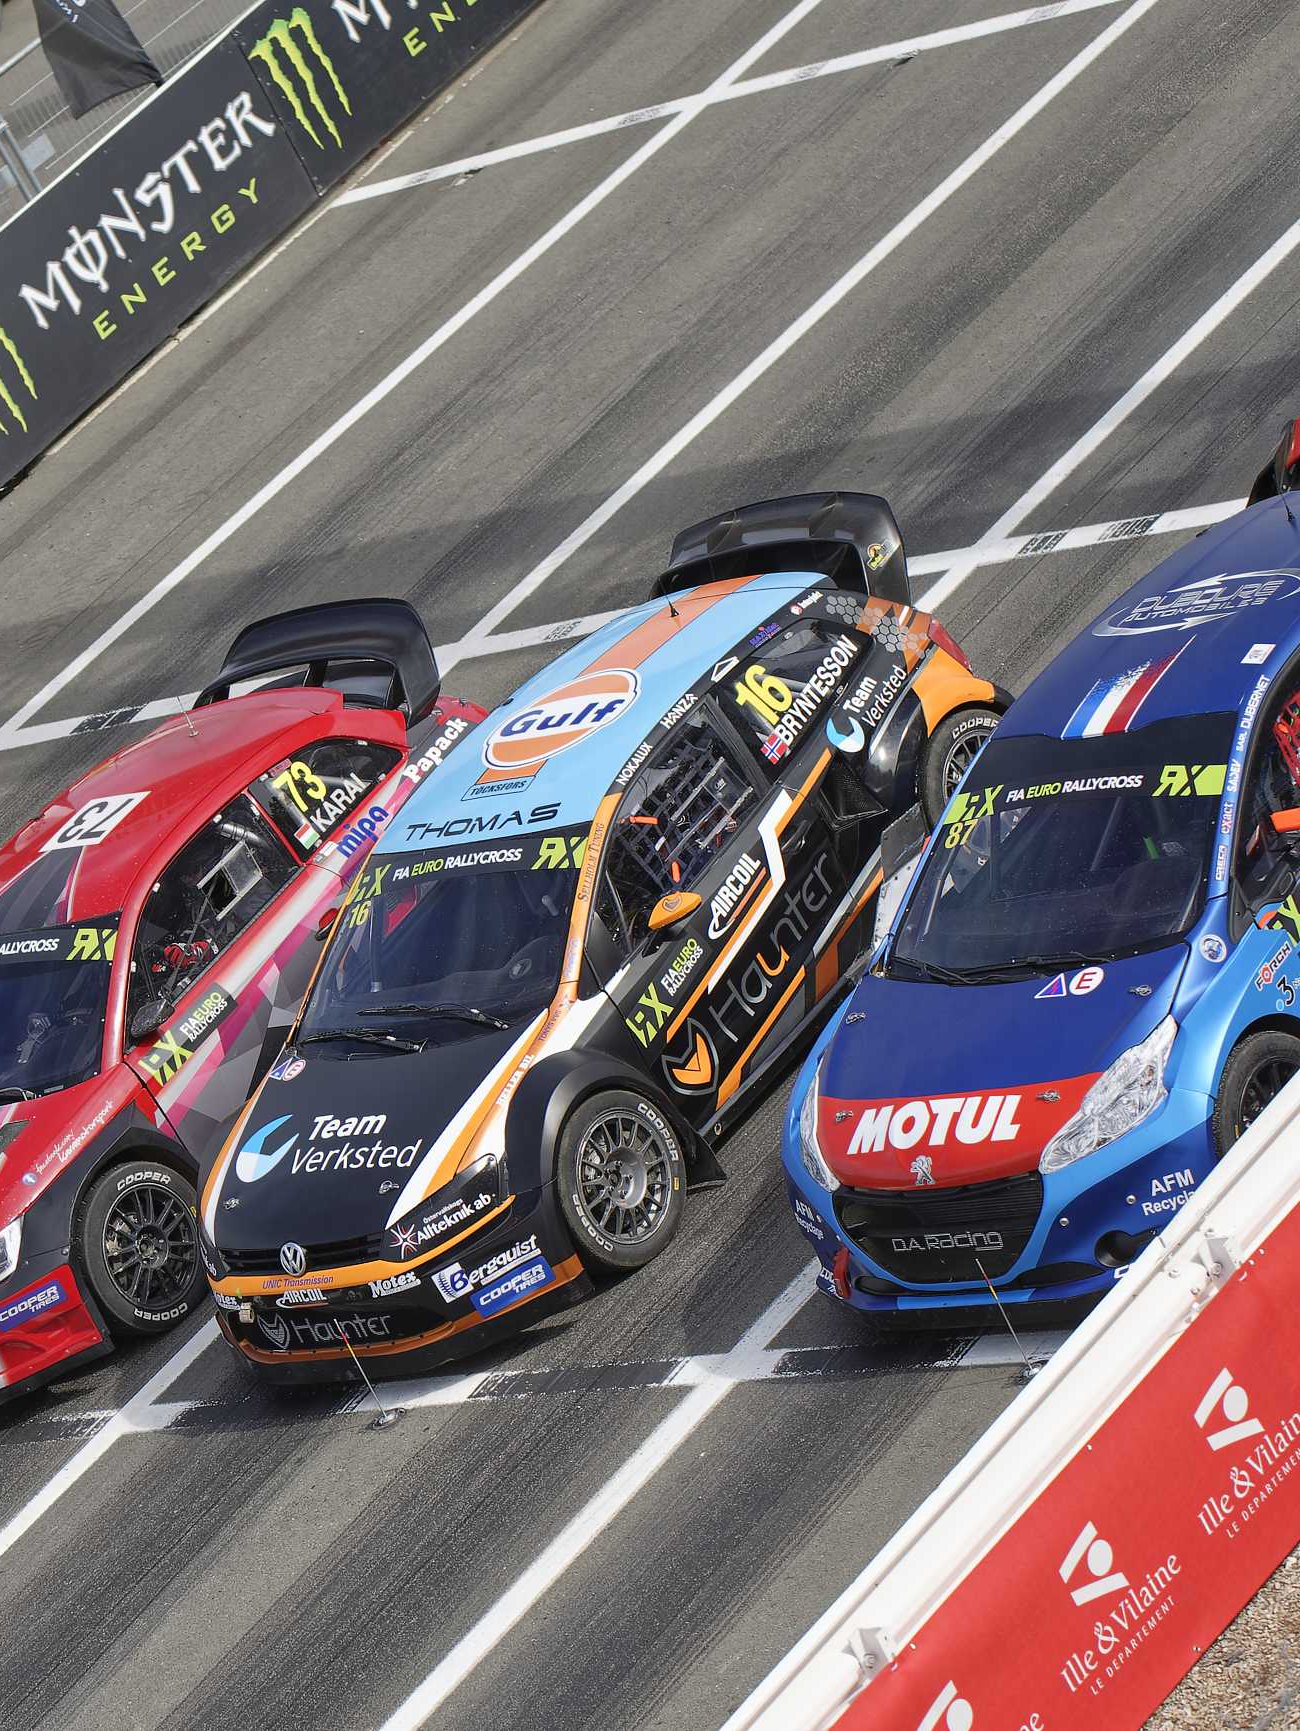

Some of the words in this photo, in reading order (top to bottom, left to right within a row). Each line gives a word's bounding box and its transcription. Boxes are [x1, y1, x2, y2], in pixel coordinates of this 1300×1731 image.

[93, 177, 261, 341] ENERGY
[735, 664, 793, 727] 16
[774, 634, 859, 745] BRYNTESSON
[843, 675, 878, 714] Team
[861, 664, 908, 729] Verksted
[500, 699, 626, 737] Gulf
[403, 717, 469, 784] Papack
[615, 742, 653, 787] NOKALUX
[272, 761, 328, 813] 73
[1006, 789, 1026, 803] FIA
[1026, 783, 1061, 798] EURO
[1061, 775, 1144, 794] RALLYCROSS
[335, 805, 390, 859] mipa
[406, 802, 562, 842] THOMAS
[944, 819, 979, 850] 87
[392, 868, 410, 883] FIA
[411, 858, 443, 878] EURO
[444, 848, 524, 871] RALLYCROSS
[347, 901, 372, 929] 16
[660, 968, 677, 991] FIA
[672, 938, 698, 973] EURO
[709, 852, 833, 1043] Haunter
[667, 945, 704, 997] RALLYCROSS
[180, 1018, 200, 1036] FIA
[194, 992, 223, 1021] EURO
[187, 999, 229, 1043] RALLYCROSS
[307, 1113, 387, 1141] Team
[637, 1103, 680, 1162] COOPER
[847, 1094, 1022, 1156] MOTUL
[291, 1138, 424, 1176] Verksted
[116, 1172, 173, 1191] COOPER
[1149, 1168, 1196, 1197] AFM
[416, 1203, 476, 1245] Allteknik
[572, 1193, 615, 1252] COOPER
[28, 1293, 61, 1313] TIRES
[278, 1287, 328, 1305] AIRCOIL
[283, 1276, 333, 1287] Transmission
[478, 1264, 545, 1306] COOPER
[512, 1271, 547, 1294] TIRES
[133, 1302, 189, 1322] COOPER
[1196, 1493, 1235, 1536] Ille
[1228, 1466, 1255, 1499] &
[1225, 1521, 1241, 1540] LE
[1060, 1649, 1099, 1694] Ille
[1094, 1620, 1120, 1655] &
[1110, 1553, 1182, 1631] Vilaine
[1090, 1680, 1105, 1696] LE
[1106, 1595, 1176, 1677] DEPARTEMENT
